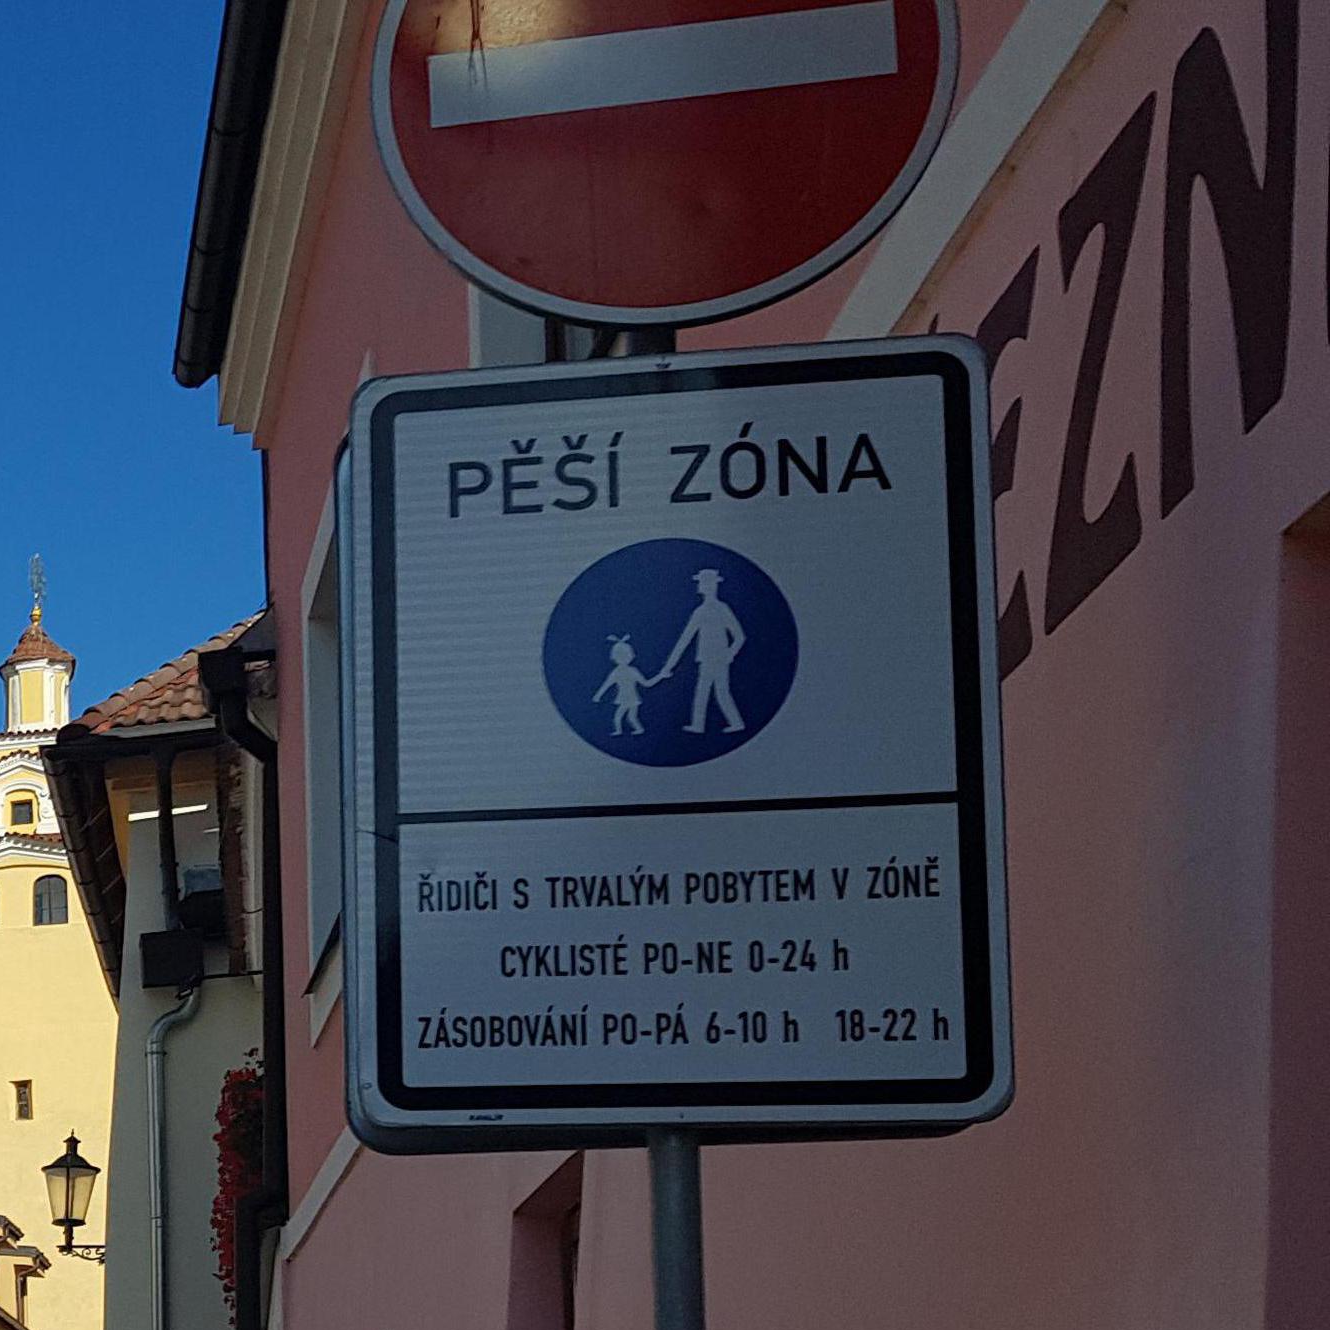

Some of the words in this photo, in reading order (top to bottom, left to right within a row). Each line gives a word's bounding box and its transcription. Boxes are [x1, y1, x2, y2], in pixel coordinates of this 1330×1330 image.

[979, 0, 1330, 692] EZN
[449, 431, 625, 518] PĚŠÍ
[670, 421, 893, 504] ZÓNA
[419, 870, 498, 913] ŘIDIČI
[512, 877, 530, 910] S
[545, 866, 670, 909] TRVALÝM
[685, 868, 816, 905] POBYTEM
[831, 867, 850, 901] V
[867, 856, 941, 900] ZÓNĚ
[500, 934, 629, 978] CYKLISTÉ
[644, 940, 733, 975] PO-NE
[748, 938, 817, 973] 0-24
[832, 938, 850, 972] h
[418, 1004, 589, 1049] ZÁSOBOVÁNÍ
[603, 1002, 690, 1046] PO-PÁ
[705, 1011, 768, 1045] 6-10
[782, 1010, 800, 1043] h
[835, 1008, 918, 1042] 18-22
[932, 1007, 950, 1041] h
